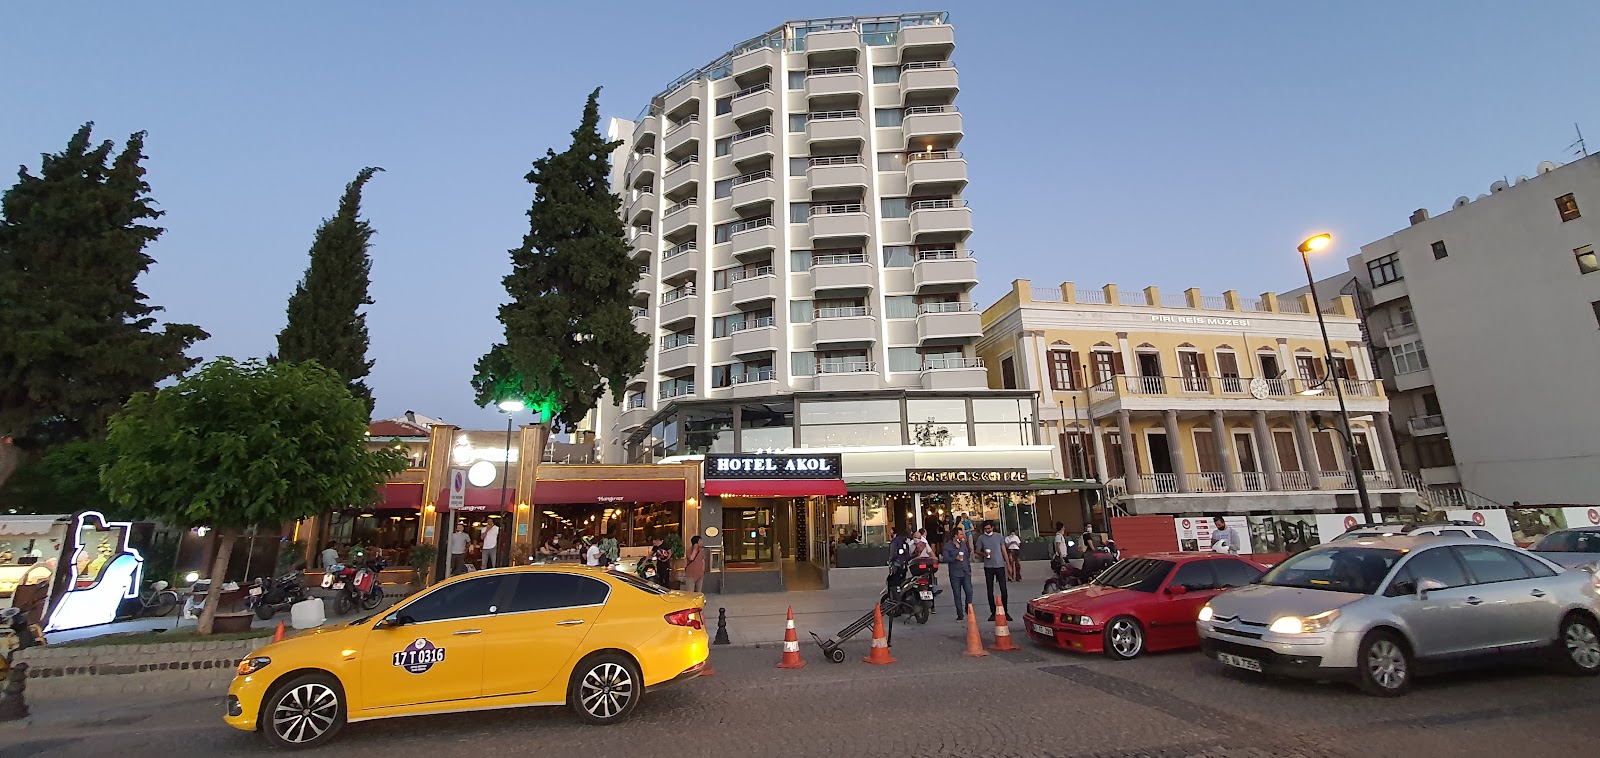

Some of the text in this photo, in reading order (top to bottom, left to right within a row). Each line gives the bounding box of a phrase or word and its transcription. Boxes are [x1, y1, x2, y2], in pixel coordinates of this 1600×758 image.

[717, 458, 831, 471] HOTEL AKOL
[395, 648, 444, 666] 17 T 0316
